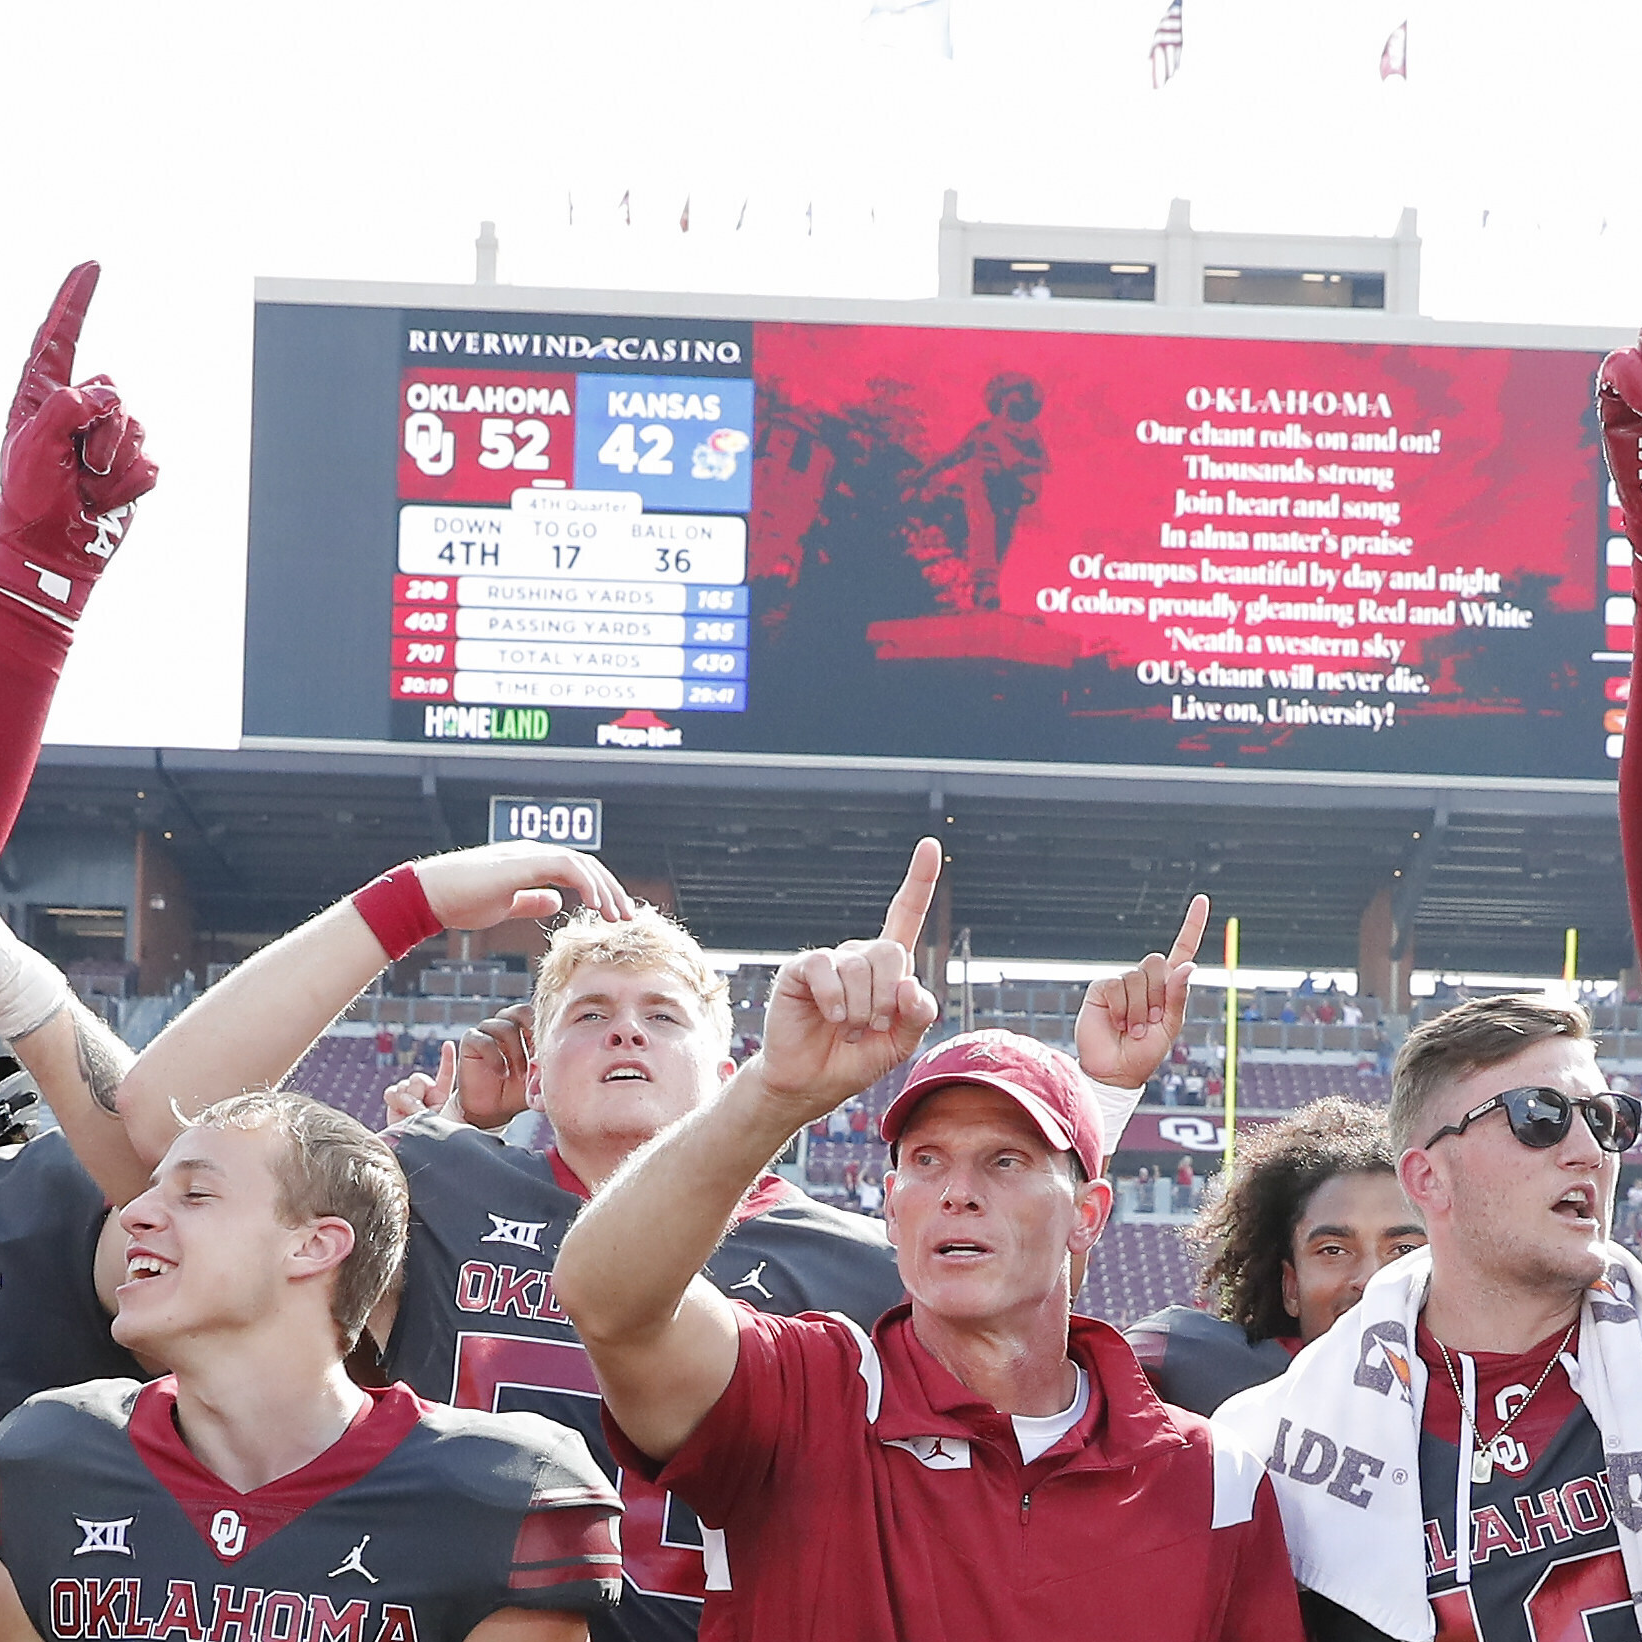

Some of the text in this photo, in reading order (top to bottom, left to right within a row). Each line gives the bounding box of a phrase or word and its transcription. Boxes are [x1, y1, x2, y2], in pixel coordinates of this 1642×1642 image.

[409, 330, 742, 364] RIVERWIND CASINO
[406, 383, 571, 415] OKLAHOMA
[608, 390, 722, 421] KANSAS
[404, 411, 455, 476] OU
[478, 417, 551, 471] 52
[597, 423, 674, 475] 42
[1135, 419, 1442, 455] Our chant rolls on and on!
[1182, 454, 1395, 493] Thousands strong
[1174, 488, 1401, 527] Join heart and song
[434, 517, 502, 535] DOWN
[534, 520, 597, 539] TO GO
[631, 524, 713, 541] BALL ON
[1160, 523, 1188, 549] In
[1189, 524, 1249, 551] alma
[1340, 530, 1414, 560] praise
[437, 541, 500, 567] 4TH
[552, 545, 582, 570] 17
[655, 548, 691, 573] 36
[1068, 553, 1502, 598] Of campus beautiful by day and night
[488, 585, 655, 605] RUSHING YARDS
[1036, 586, 1534, 630] Of colors proudly gleaming Red and White
[404, 611, 449, 633] 403
[488, 617, 653, 636] PASSING YARDS
[693, 622, 735, 642] 265
[405, 643, 445, 664] 701
[499, 649, 641, 668] TOTAL YARDS
[692, 653, 735, 673] 430
[1245, 637, 1263, 655] a
[1264, 633, 1360, 658] western
[1361, 632, 1406, 663] sky
[496, 681, 637, 700] TIME OF POSS
[1135, 660, 1431, 696] OU's chant will never die.
[424, 704, 550, 740] HOMELAND
[1171, 695, 1396, 732] Live on, University!
[509, 804, 594, 841] 10:00
[209, 1508, 248, 1558] OU
